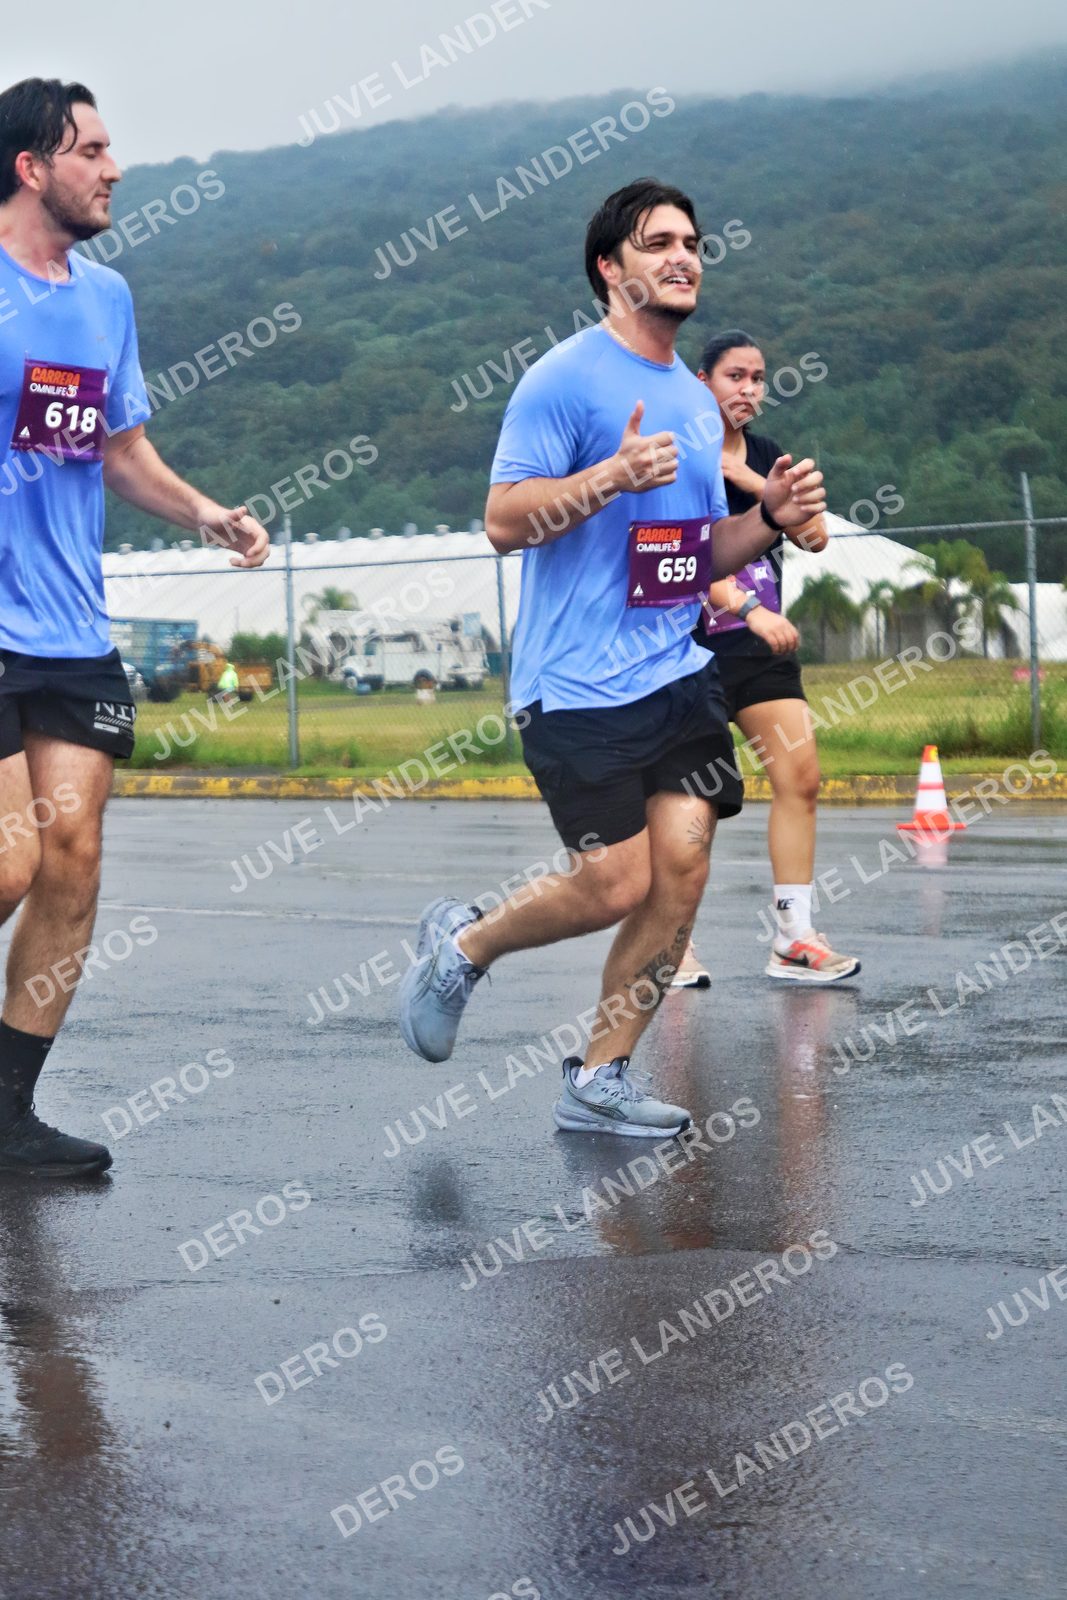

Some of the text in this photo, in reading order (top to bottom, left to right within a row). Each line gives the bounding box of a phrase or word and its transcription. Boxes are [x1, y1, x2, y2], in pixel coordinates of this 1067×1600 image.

[31, 367, 80, 386] CARRERA
[45, 401, 97, 434] 618
[636, 528, 683, 543] CARRERA
[657, 556, 697, 584] 659
